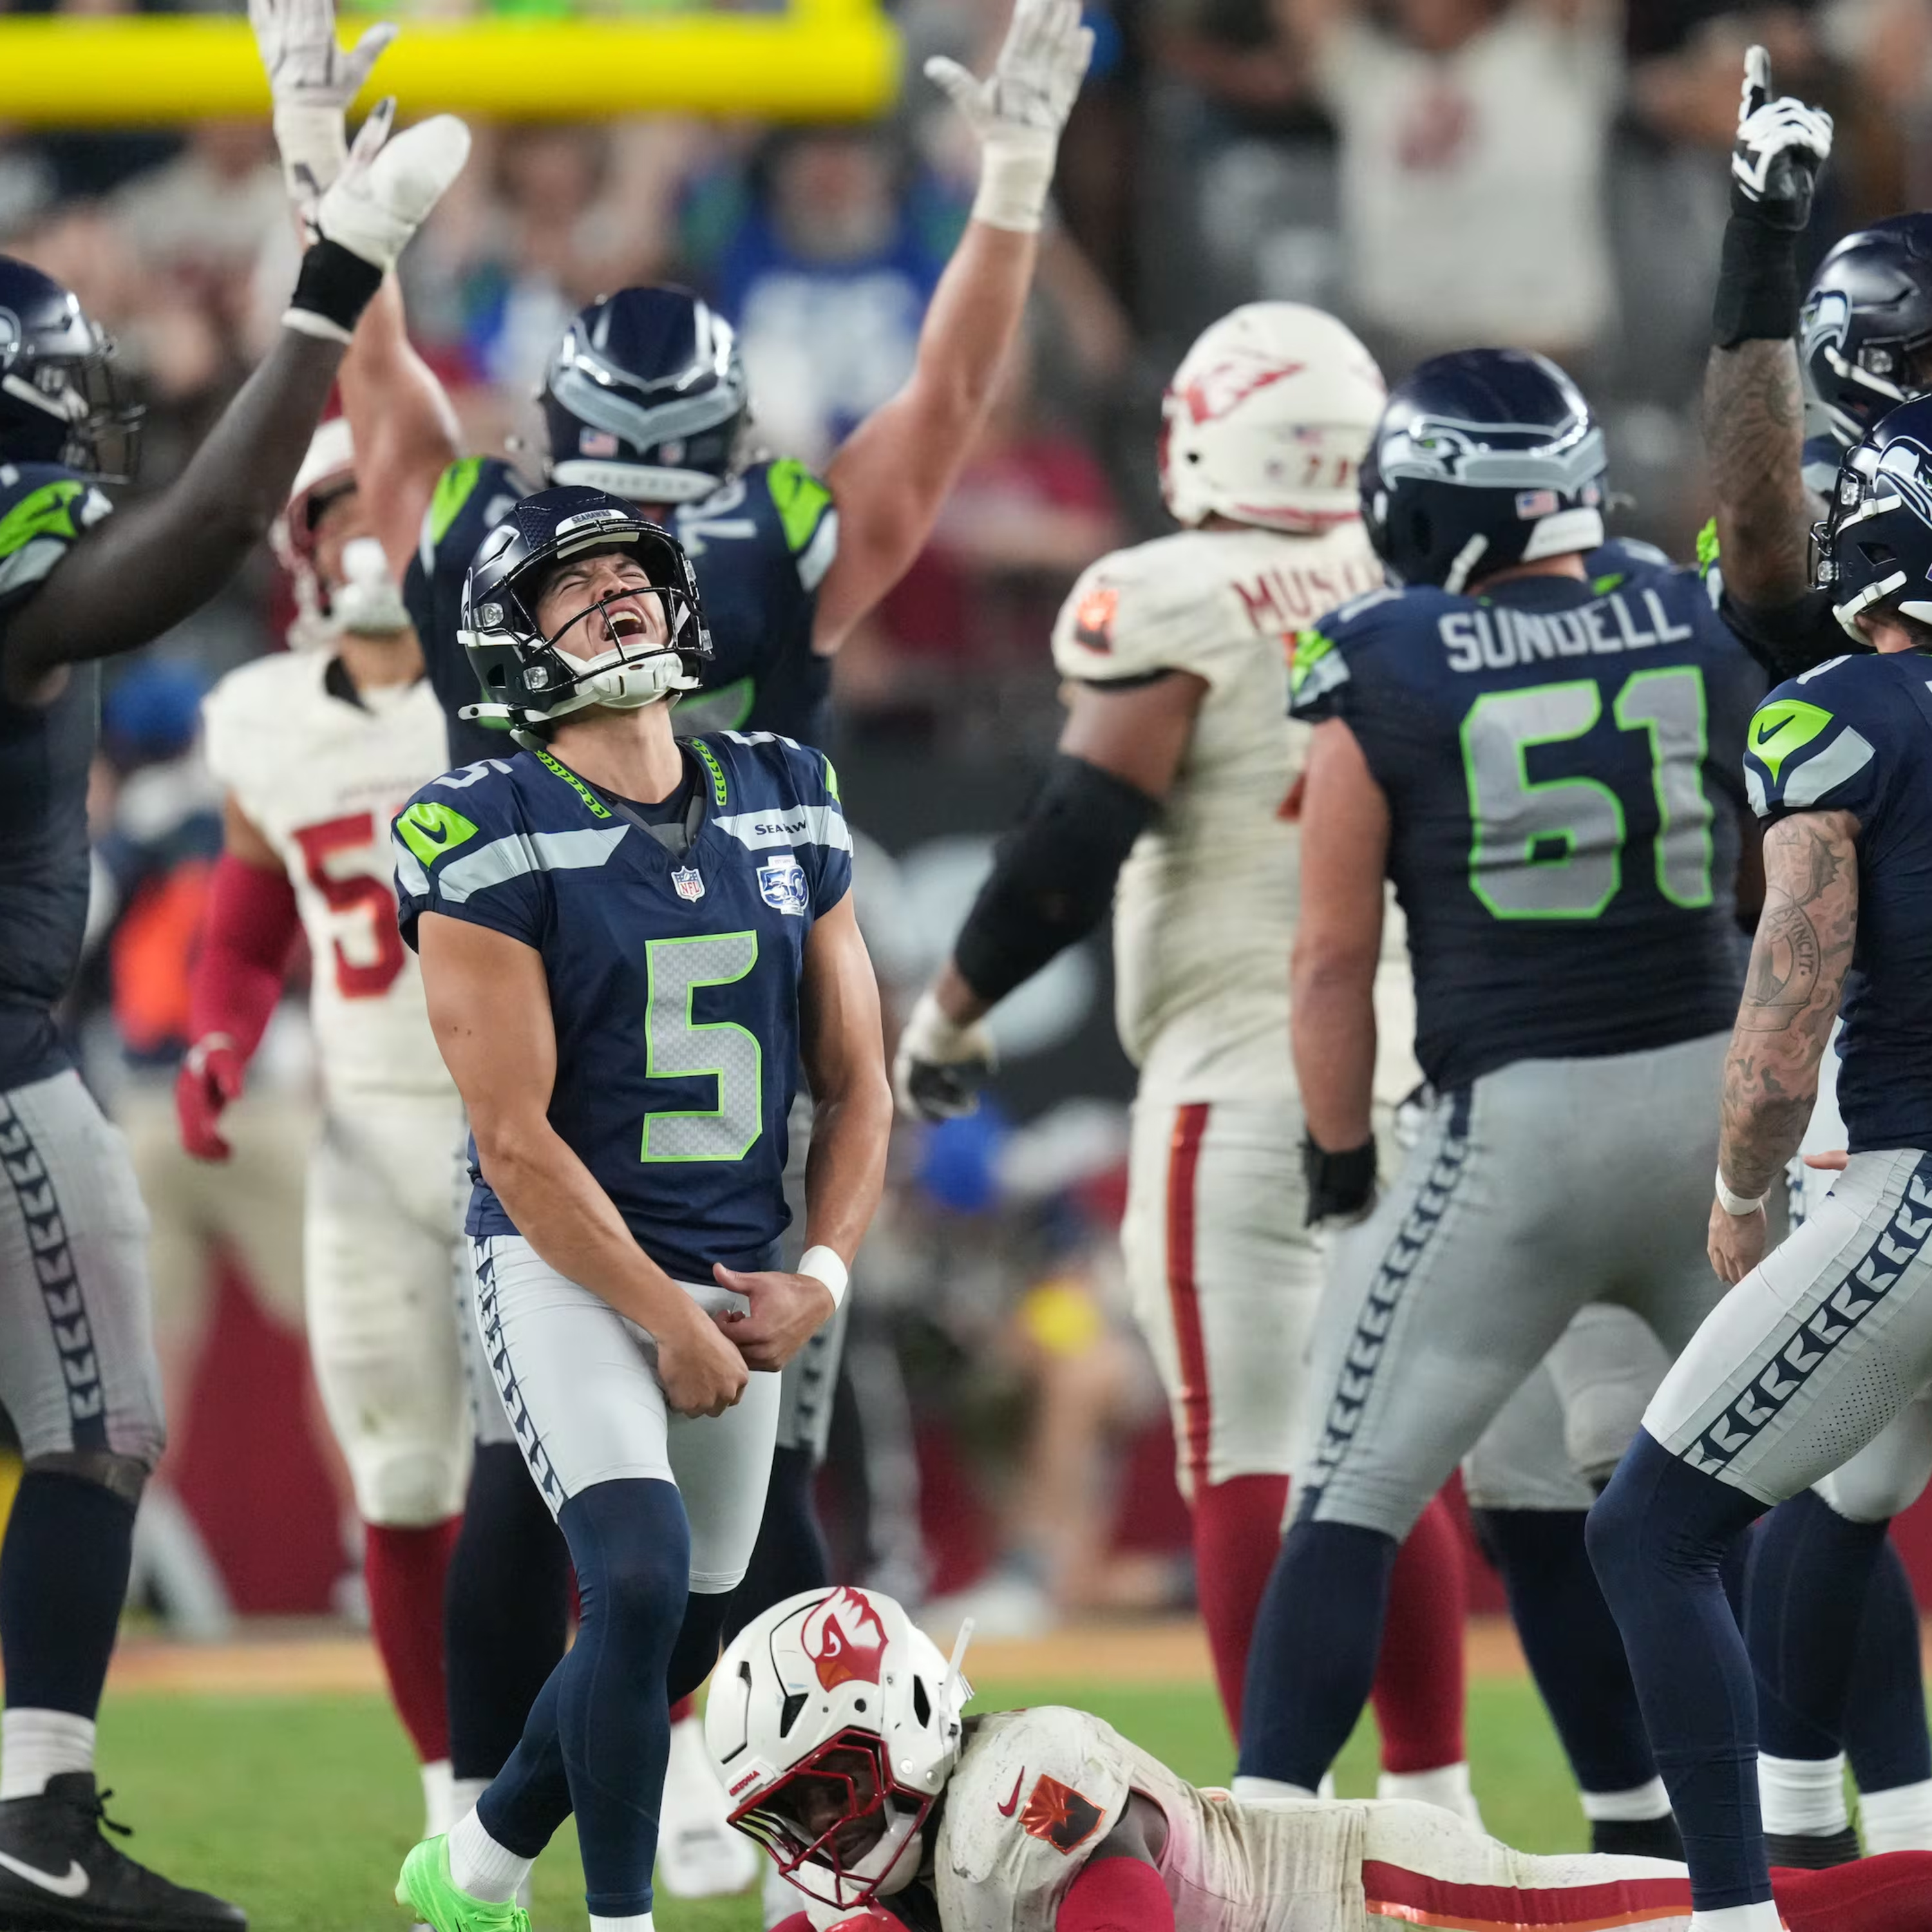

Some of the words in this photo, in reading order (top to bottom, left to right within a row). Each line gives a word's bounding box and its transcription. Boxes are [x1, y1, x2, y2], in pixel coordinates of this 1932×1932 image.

[571, 509, 611, 524] SEAHAWKS
[1438, 588, 1692, 672] SUNDELL
[431, 759, 514, 789] 5
[1459, 665, 1714, 919] 61
[680, 882, 699, 895] NFL
[641, 929, 762, 1163] 5
